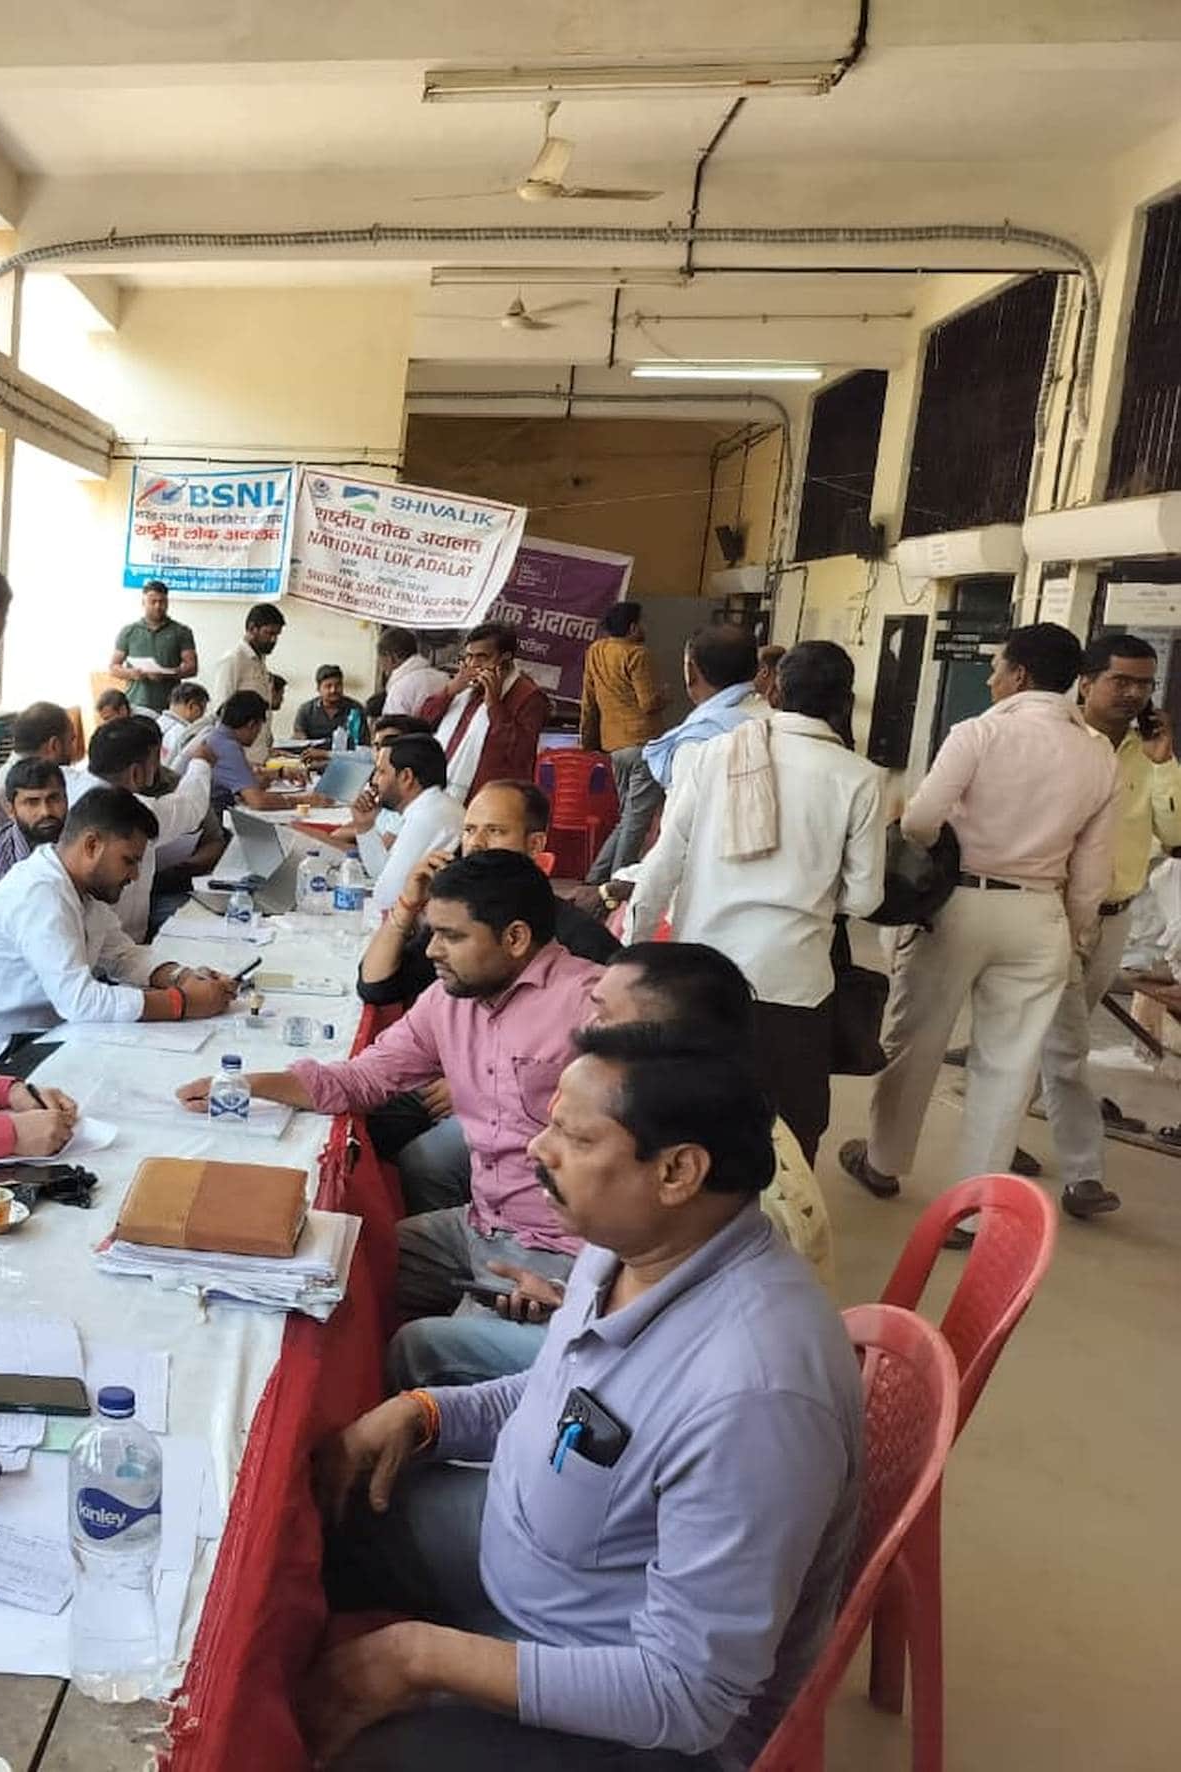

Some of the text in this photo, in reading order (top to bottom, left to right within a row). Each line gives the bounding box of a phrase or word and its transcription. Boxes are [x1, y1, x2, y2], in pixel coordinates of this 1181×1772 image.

[189, 481, 284, 508] BSNL
[390, 495, 495, 528] SHIVALIK
[135, 521, 179, 542] राष्ट्रीय
[183, 525, 218, 541] लोक
[313, 505, 367, 531] राष्ट्रीय
[370, 519, 413, 541] लोक
[416, 530, 482, 555] अदालत
[307, 530, 380, 561] NATIONAL
[383, 548, 412, 569] LOK
[413, 558, 474, 578] ADALAT
